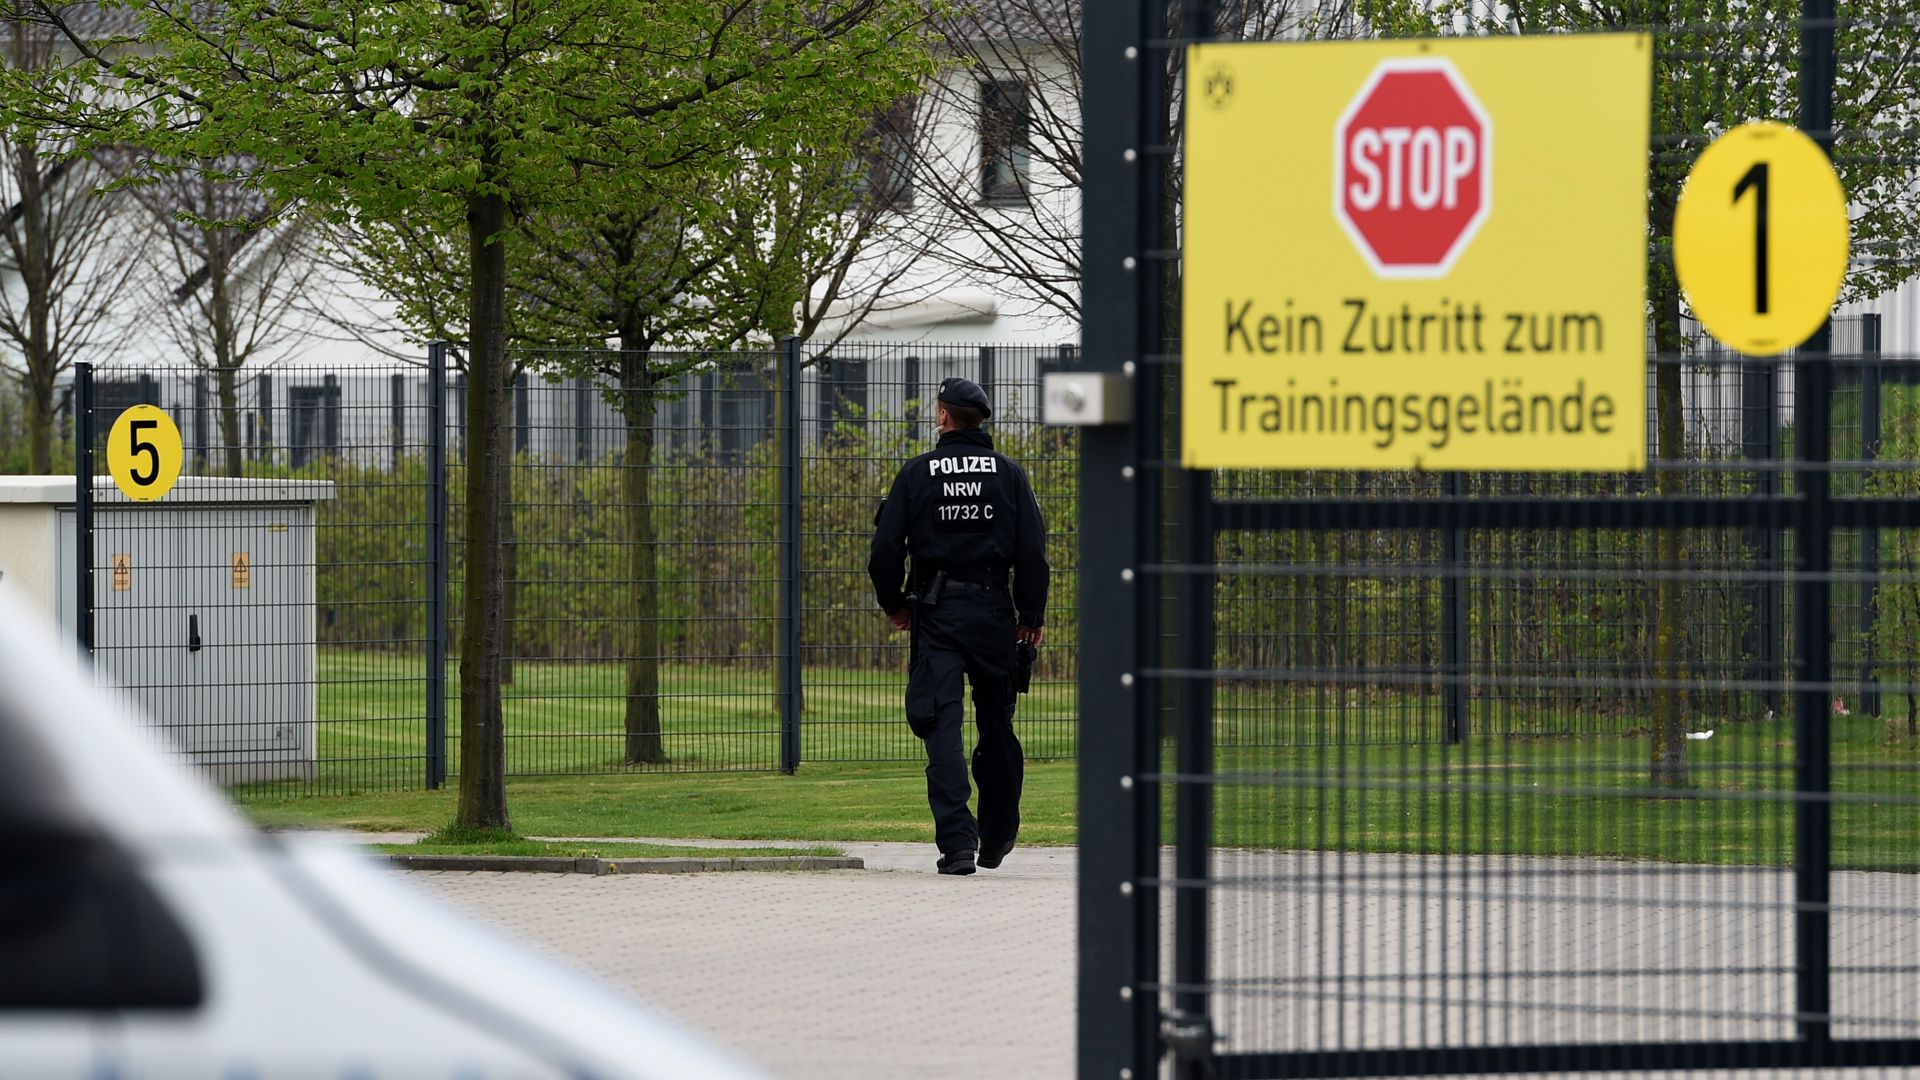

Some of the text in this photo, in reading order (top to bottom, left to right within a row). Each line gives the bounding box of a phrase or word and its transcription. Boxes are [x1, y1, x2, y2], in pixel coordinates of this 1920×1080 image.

[1350, 126, 1476, 212] STOP
[1731, 161, 1771, 315] 1
[1225, 299, 1603, 353] Kein Zutritt zum
[1211, 379, 1616, 448] Trainingsgelände
[130, 420, 160, 486] 5
[929, 456, 997, 476] POLIZEI
[938, 504, 994, 520] 11732 C
[943, 482, 982, 497] NRW
